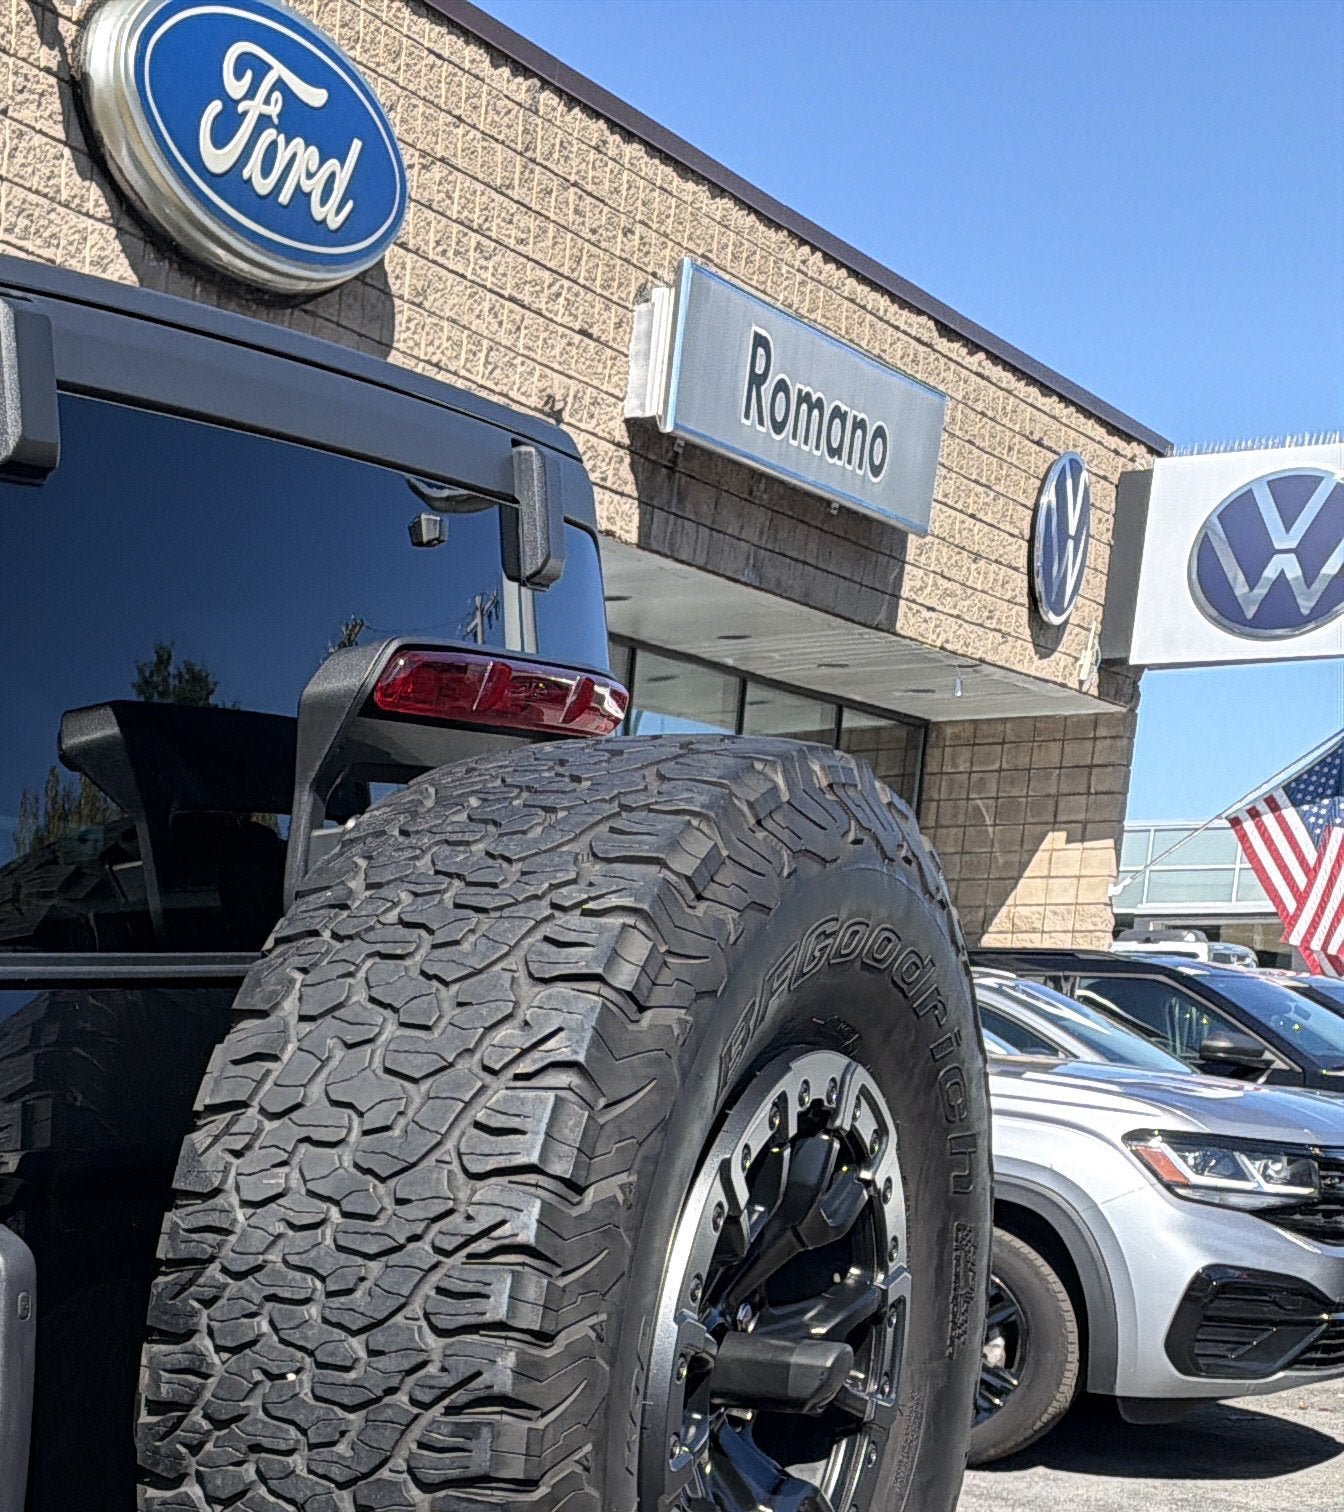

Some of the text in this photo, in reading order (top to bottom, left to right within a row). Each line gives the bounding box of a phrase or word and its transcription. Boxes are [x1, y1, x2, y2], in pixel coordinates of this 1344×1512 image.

[199, 40, 362, 230] Ford
[740, 324, 889, 482] Romano
[717, 914, 977, 1195] BFGoodrich
